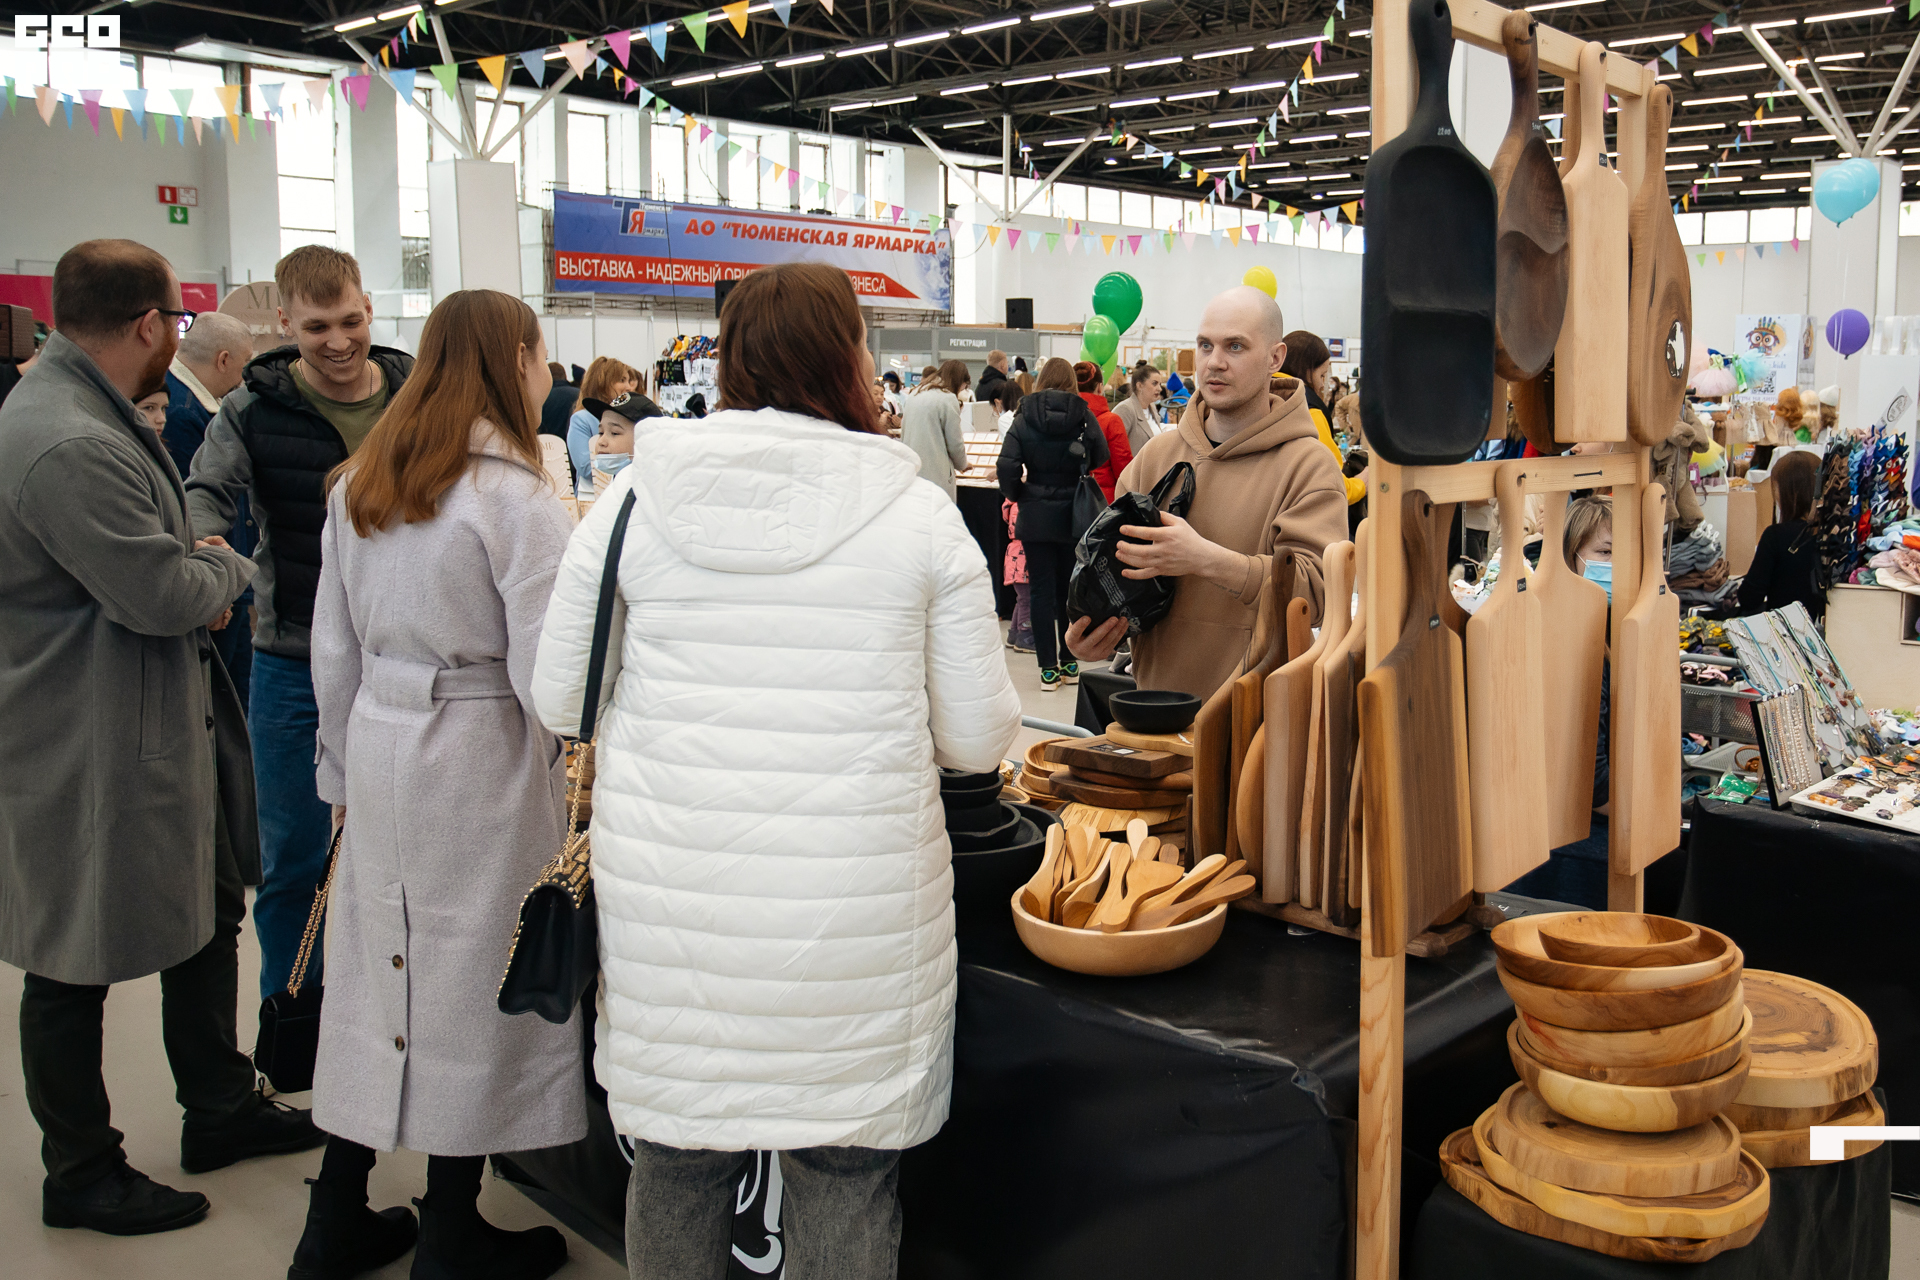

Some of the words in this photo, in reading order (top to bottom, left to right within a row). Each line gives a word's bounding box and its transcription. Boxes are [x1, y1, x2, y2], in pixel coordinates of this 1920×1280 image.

[684, 219, 716, 236] АО
[559, 257, 635, 279] ВЫСТАВКА
[646, 263, 721, 284] НАДЕЖНЫЙ
[949, 338, 987, 348] РЕГИСТРАЦИЯ
